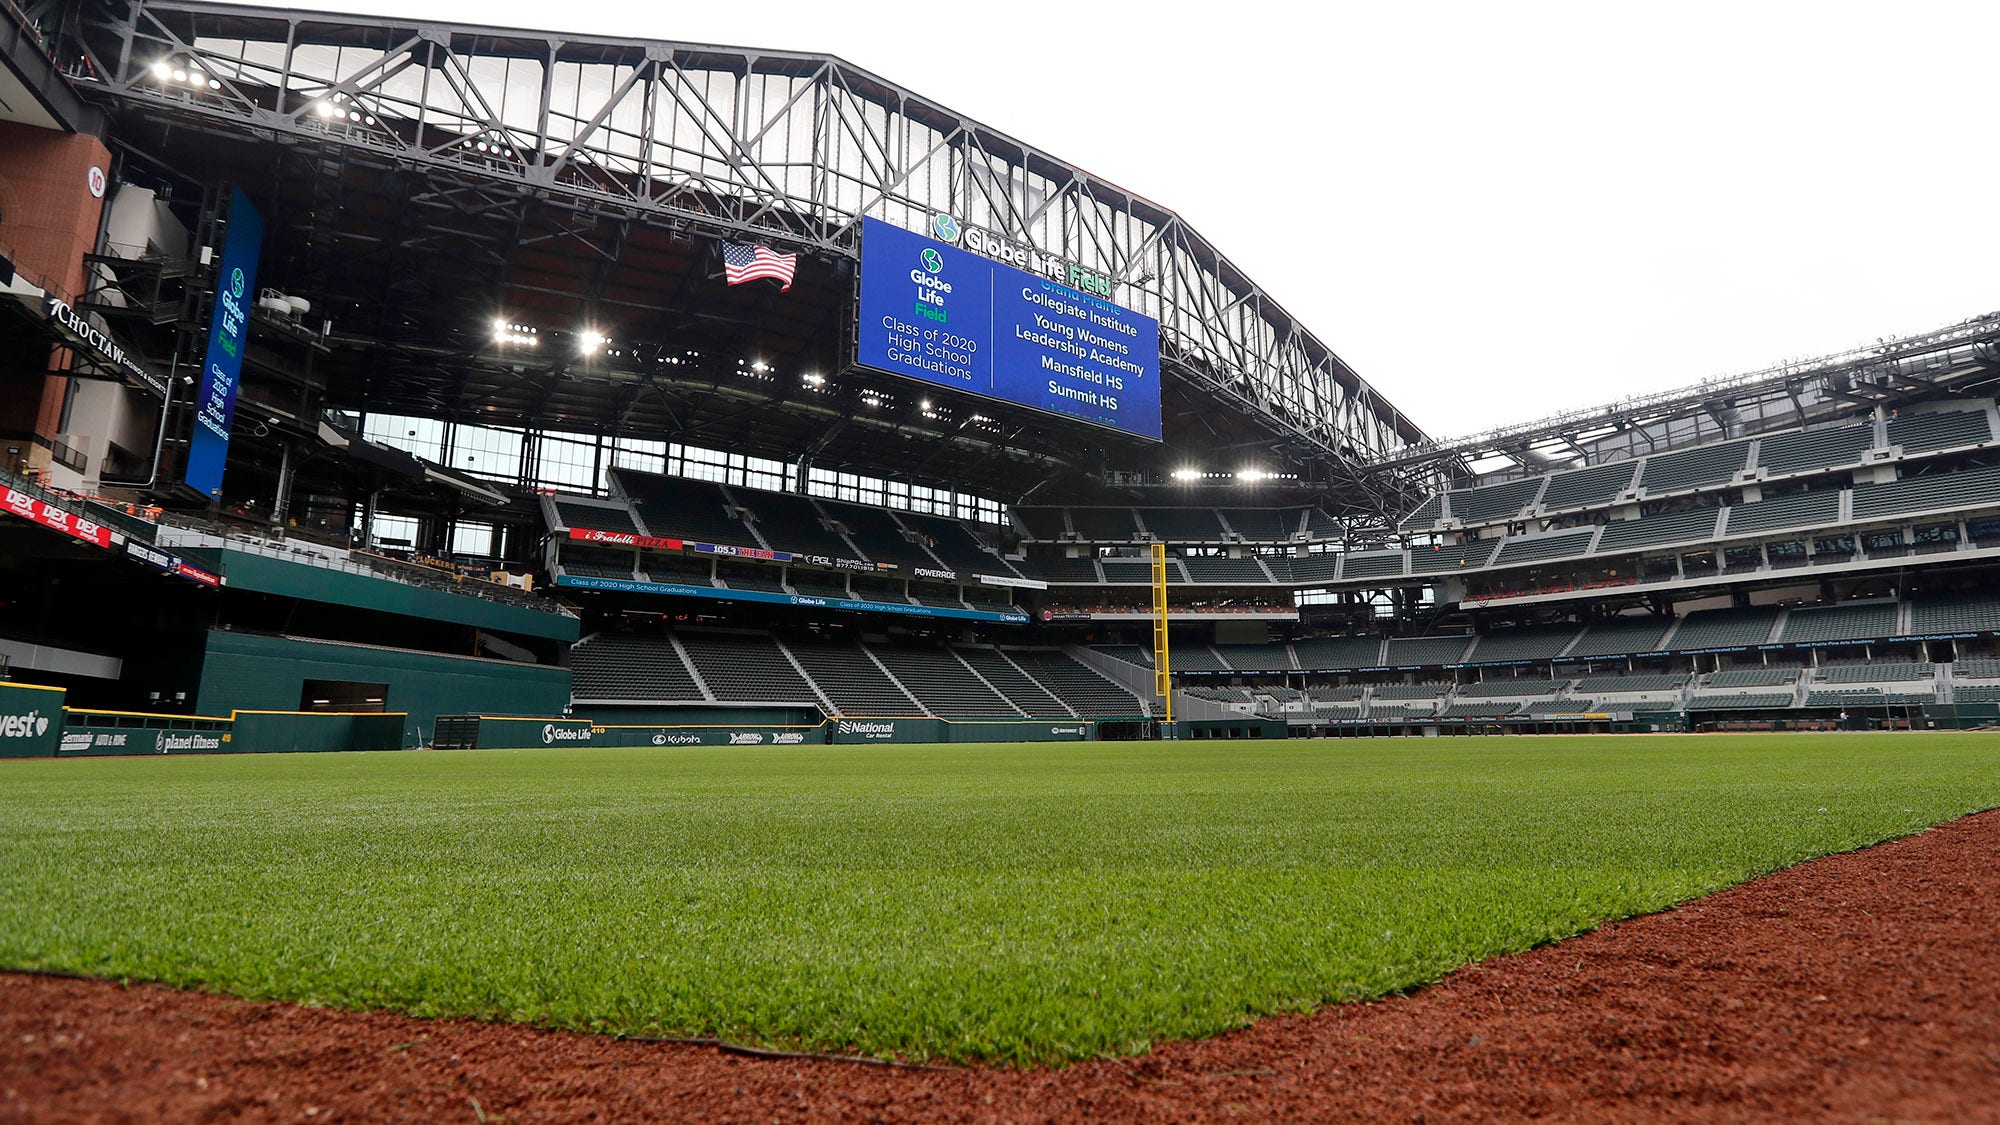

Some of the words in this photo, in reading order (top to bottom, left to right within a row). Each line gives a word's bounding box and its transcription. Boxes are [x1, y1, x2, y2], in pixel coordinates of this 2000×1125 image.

[965, 228, 1027, 266] Globe
[1029, 249, 1066, 280] Life
[1068, 265, 1112, 297] Field
[910, 269, 952, 294] Globe
[222, 290, 244, 323] Globe
[918, 286, 944, 306] Life
[222, 311, 238, 337] Life
[915, 302, 947, 323] Field
[1022, 287, 1087, 319] Collegiate
[1090, 310, 1138, 337] Institute
[58, 303, 124, 364] CHOCTAW
[218, 329, 237, 357] Field
[882, 315, 919, 337] Class
[924, 330, 938, 341] of
[942, 333, 977, 353] 2020
[1034, 312, 1074, 340] Young
[1077, 327, 1129, 355] Womens
[888, 332, 921, 352] High
[926, 343, 971, 366] School
[1015, 324, 1087, 359] Leadership
[1090, 348, 1144, 377] Academy
[887, 348, 972, 380] Graduations
[1041, 355, 1102, 384] Mansfield
[1106, 374, 1123, 390] HS
[1048, 380, 1097, 405] Summit
[1100, 394, 1118, 410] HS
[5, 489, 37, 510] DEX
[42, 504, 70, 524] DEX
[75, 517, 100, 536] DEX
[593, 530, 635, 544] Fratelli
[636, 538, 669, 548] PIZZA
[713, 545, 736, 555] 105.3
[738, 548, 754, 557] THE
[756, 550, 774, 559] FAN
[812, 555, 832, 565] PGL
[570, 578, 589, 587] Class
[619, 582, 634, 591] High
[636, 583, 658, 592] School
[660, 585, 697, 595] Graduations
[914, 568, 956, 580] POWERADE
[799, 597, 814, 605] Globe
[163, 733, 191, 754] planet
[192, 733, 219, 749] fitness
[555, 728, 577, 741] Globe
[577, 727, 592, 740] Life
[667, 735, 701, 744] Kubota
